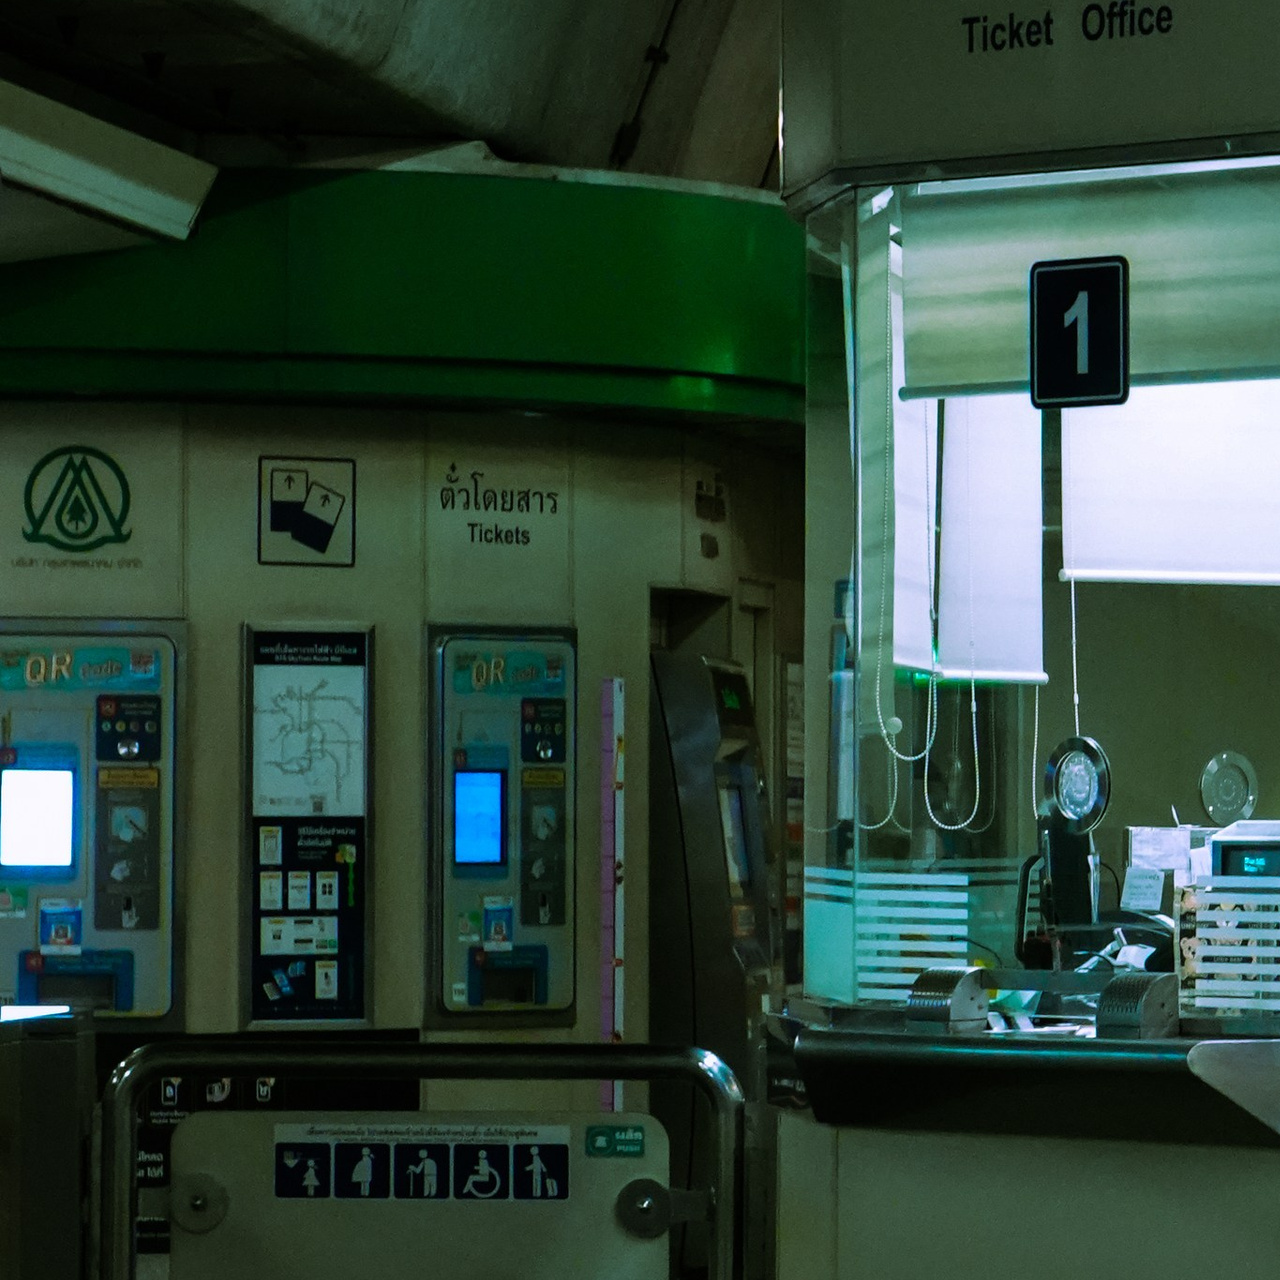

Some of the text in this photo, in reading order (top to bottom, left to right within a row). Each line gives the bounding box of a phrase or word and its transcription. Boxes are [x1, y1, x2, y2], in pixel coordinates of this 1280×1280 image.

[961, 10, 1054, 53] Ticket
[1062, 289, 1091, 376] 1
[440, 462, 559, 514] ตั๋วโดยสาร
[467, 522, 531, 545] Tickets
[24, 651, 73, 687] QR
[471, 656, 506, 691] QR
